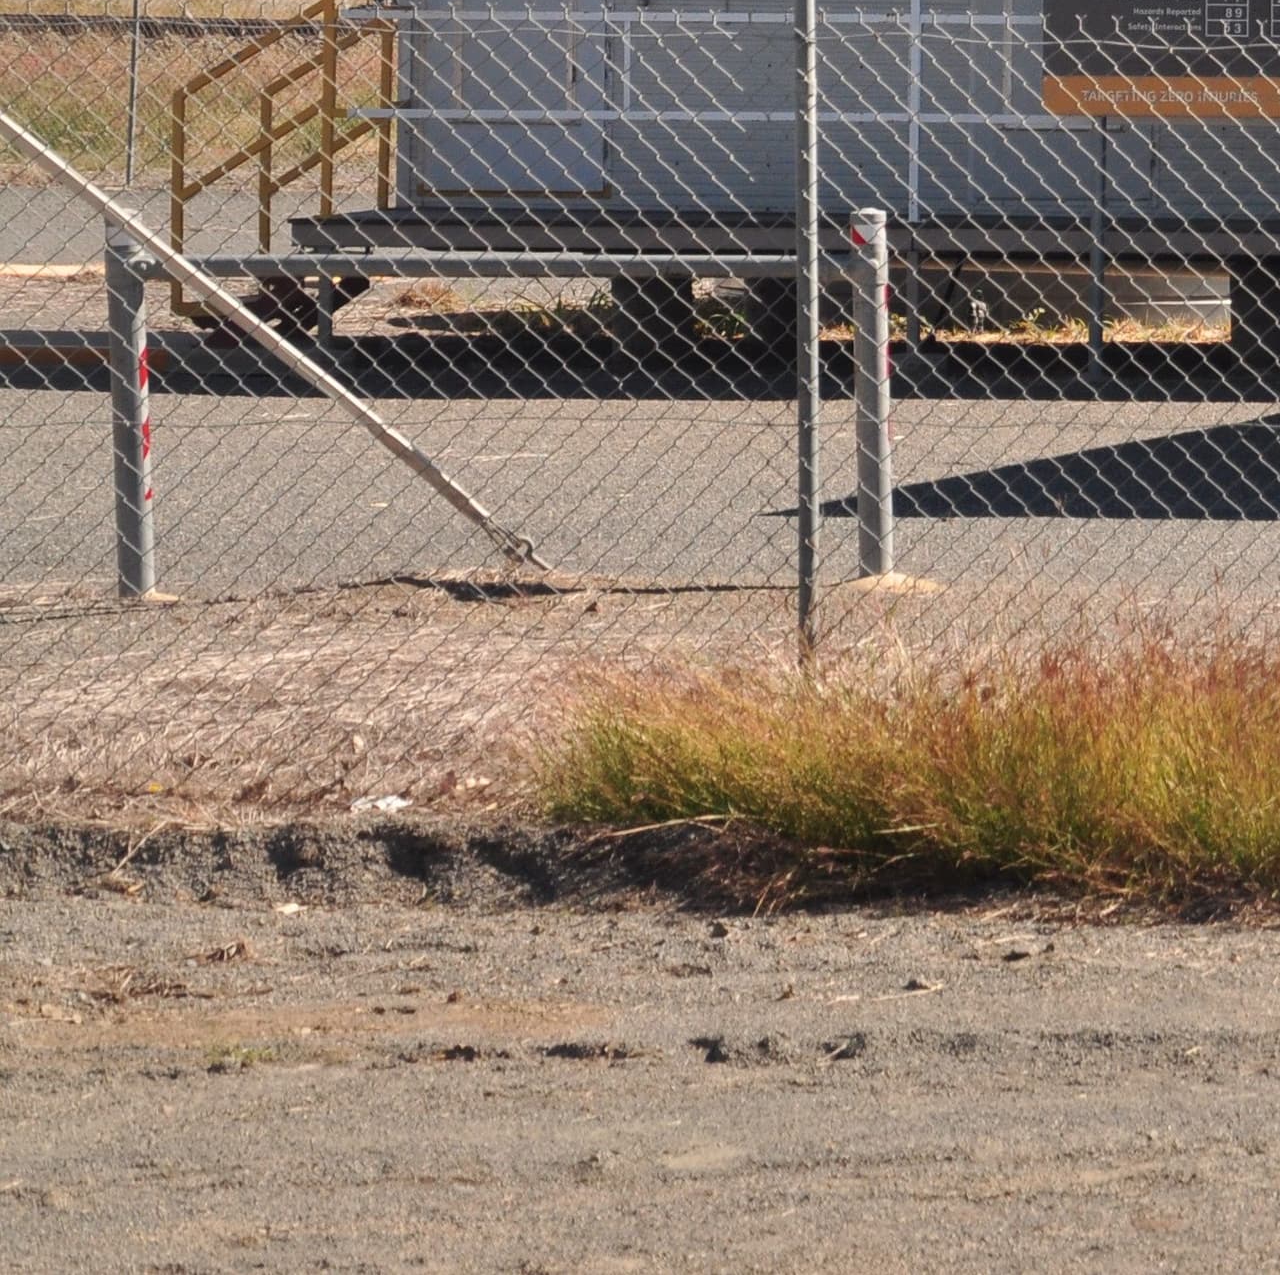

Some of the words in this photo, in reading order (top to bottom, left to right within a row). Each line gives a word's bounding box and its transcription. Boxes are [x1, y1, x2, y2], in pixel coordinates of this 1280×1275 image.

[1166, 7, 1201, 16] Reported
[1225, 8, 1243, 18] 89
[1159, 91, 1193, 102] ZERO
